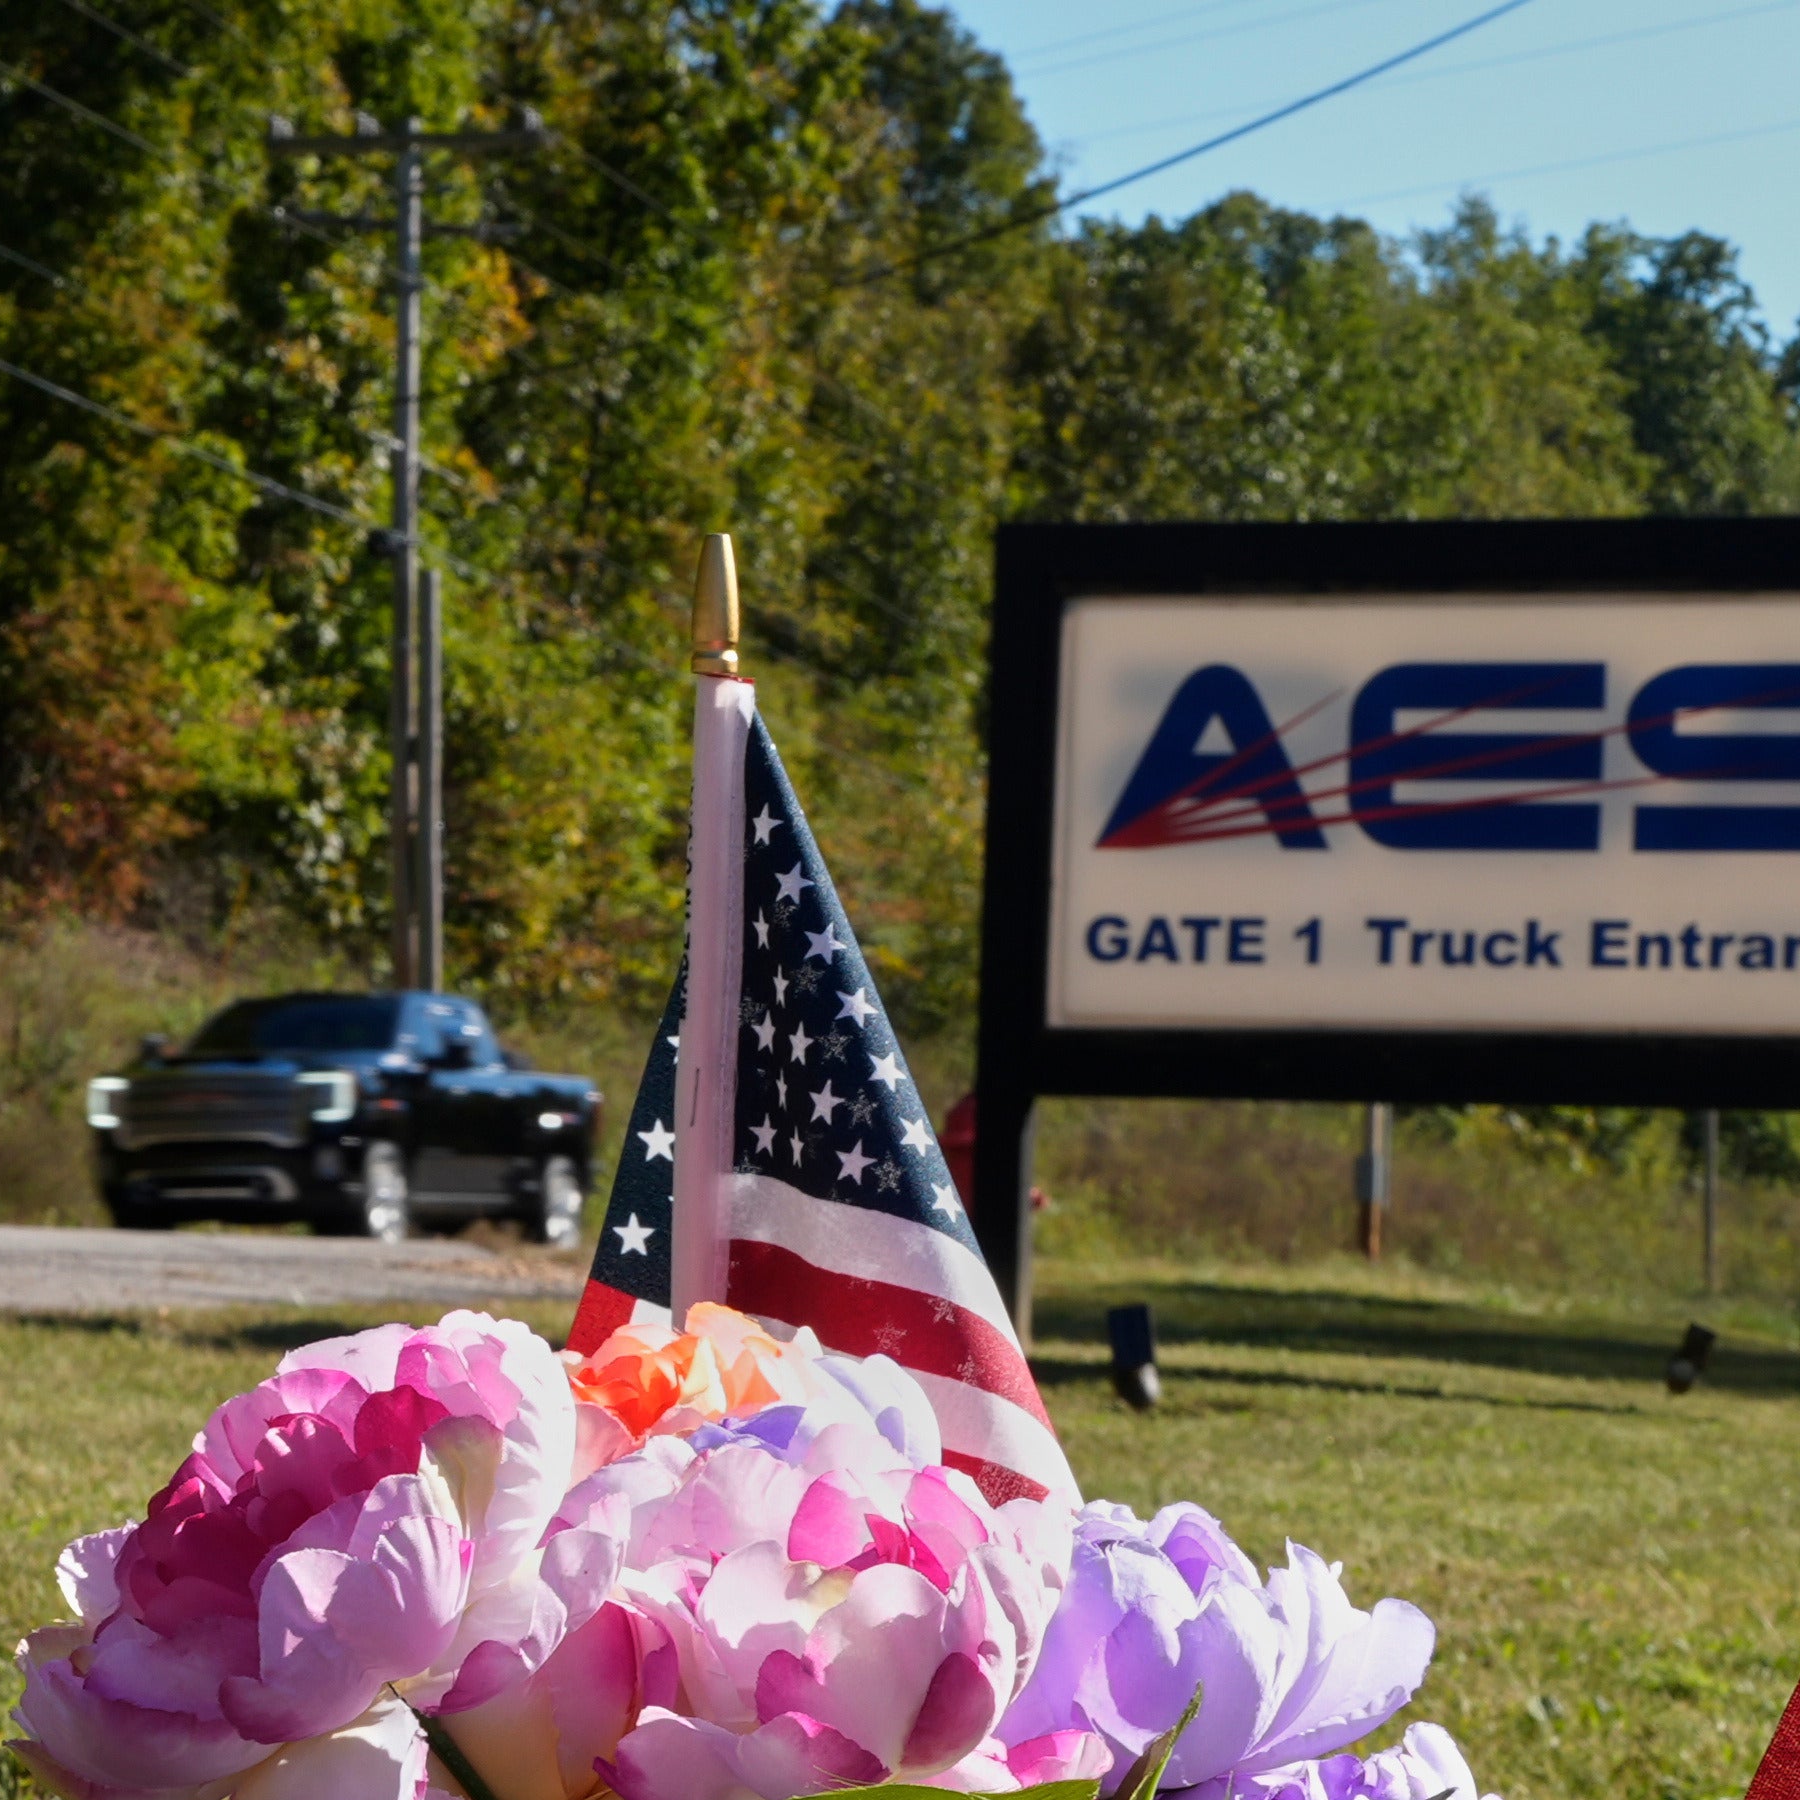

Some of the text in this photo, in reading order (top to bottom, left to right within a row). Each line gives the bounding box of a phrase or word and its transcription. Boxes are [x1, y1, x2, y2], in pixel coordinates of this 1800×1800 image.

[1084, 914, 1266, 966] GATE
[1294, 917, 1322, 966] 1
[1364, 917, 1562, 968] Truck
